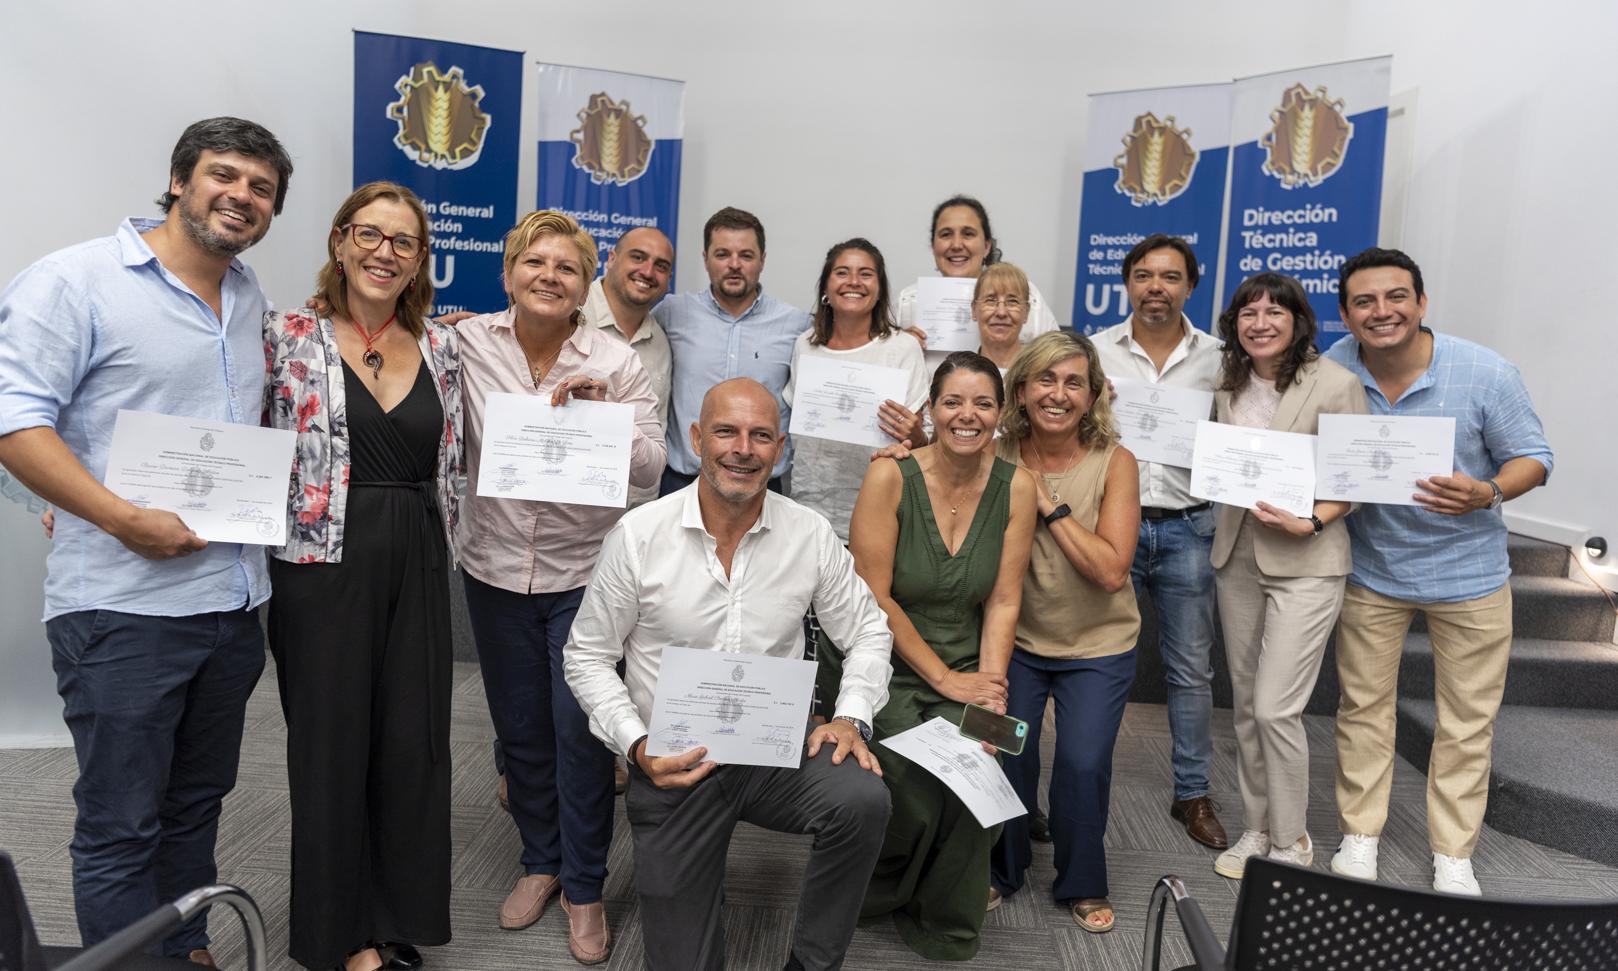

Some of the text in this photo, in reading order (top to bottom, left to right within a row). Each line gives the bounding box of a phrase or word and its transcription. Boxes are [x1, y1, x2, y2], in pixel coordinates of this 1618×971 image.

[439, 201, 494, 219] General
[1243, 203, 1338, 227] Dirección
[611, 213, 658, 228] General
[429, 236, 504, 253] Profesional
[1240, 227, 1318, 249] Técnica
[1088, 249, 1104, 261] de
[1239, 249, 1347, 272] de Gestión
[1085, 283, 1129, 317] UT
